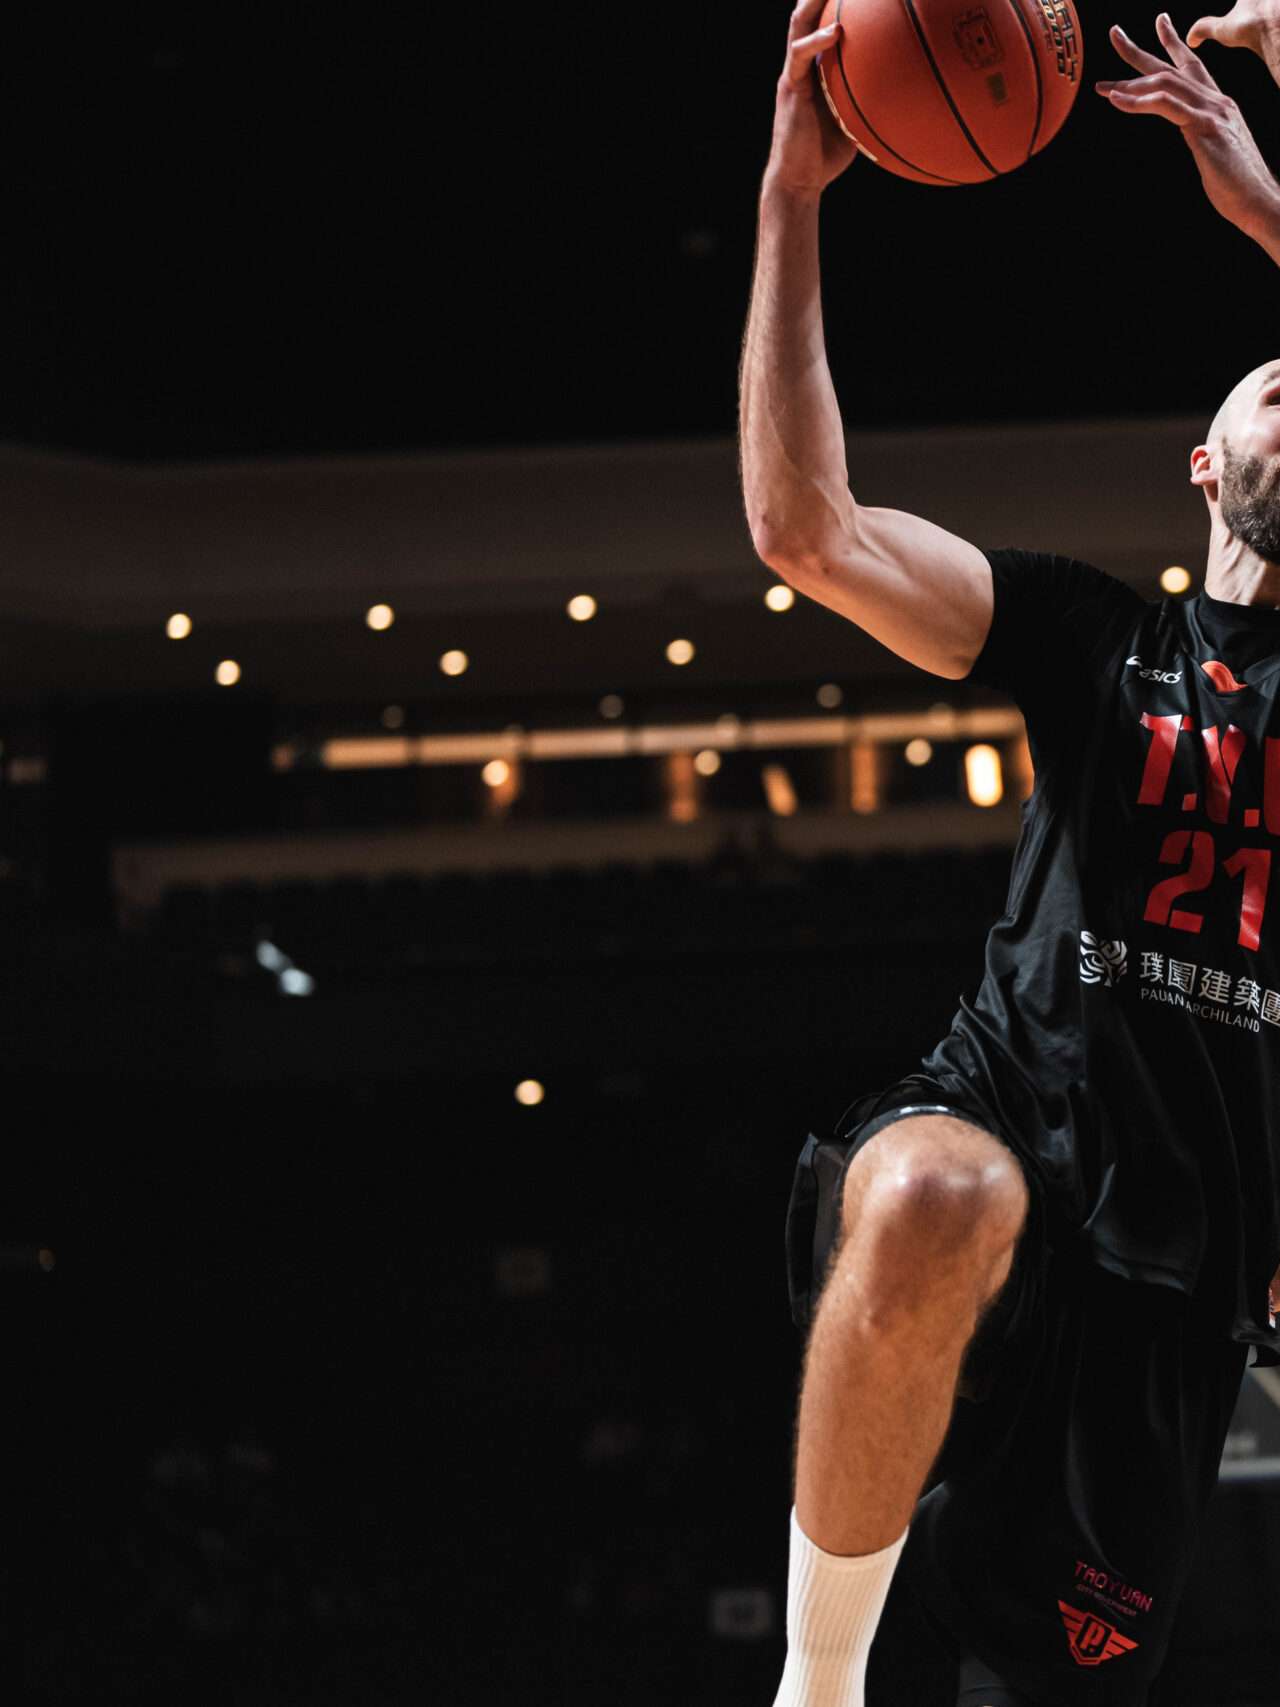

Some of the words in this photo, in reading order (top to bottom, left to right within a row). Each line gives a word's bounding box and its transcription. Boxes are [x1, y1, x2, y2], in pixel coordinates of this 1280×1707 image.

[1143, 830, 1271, 952] 21
[1141, 988, 1184, 1007] PAUAN
[1185, 1001, 1260, 1033] ARCHILAND
